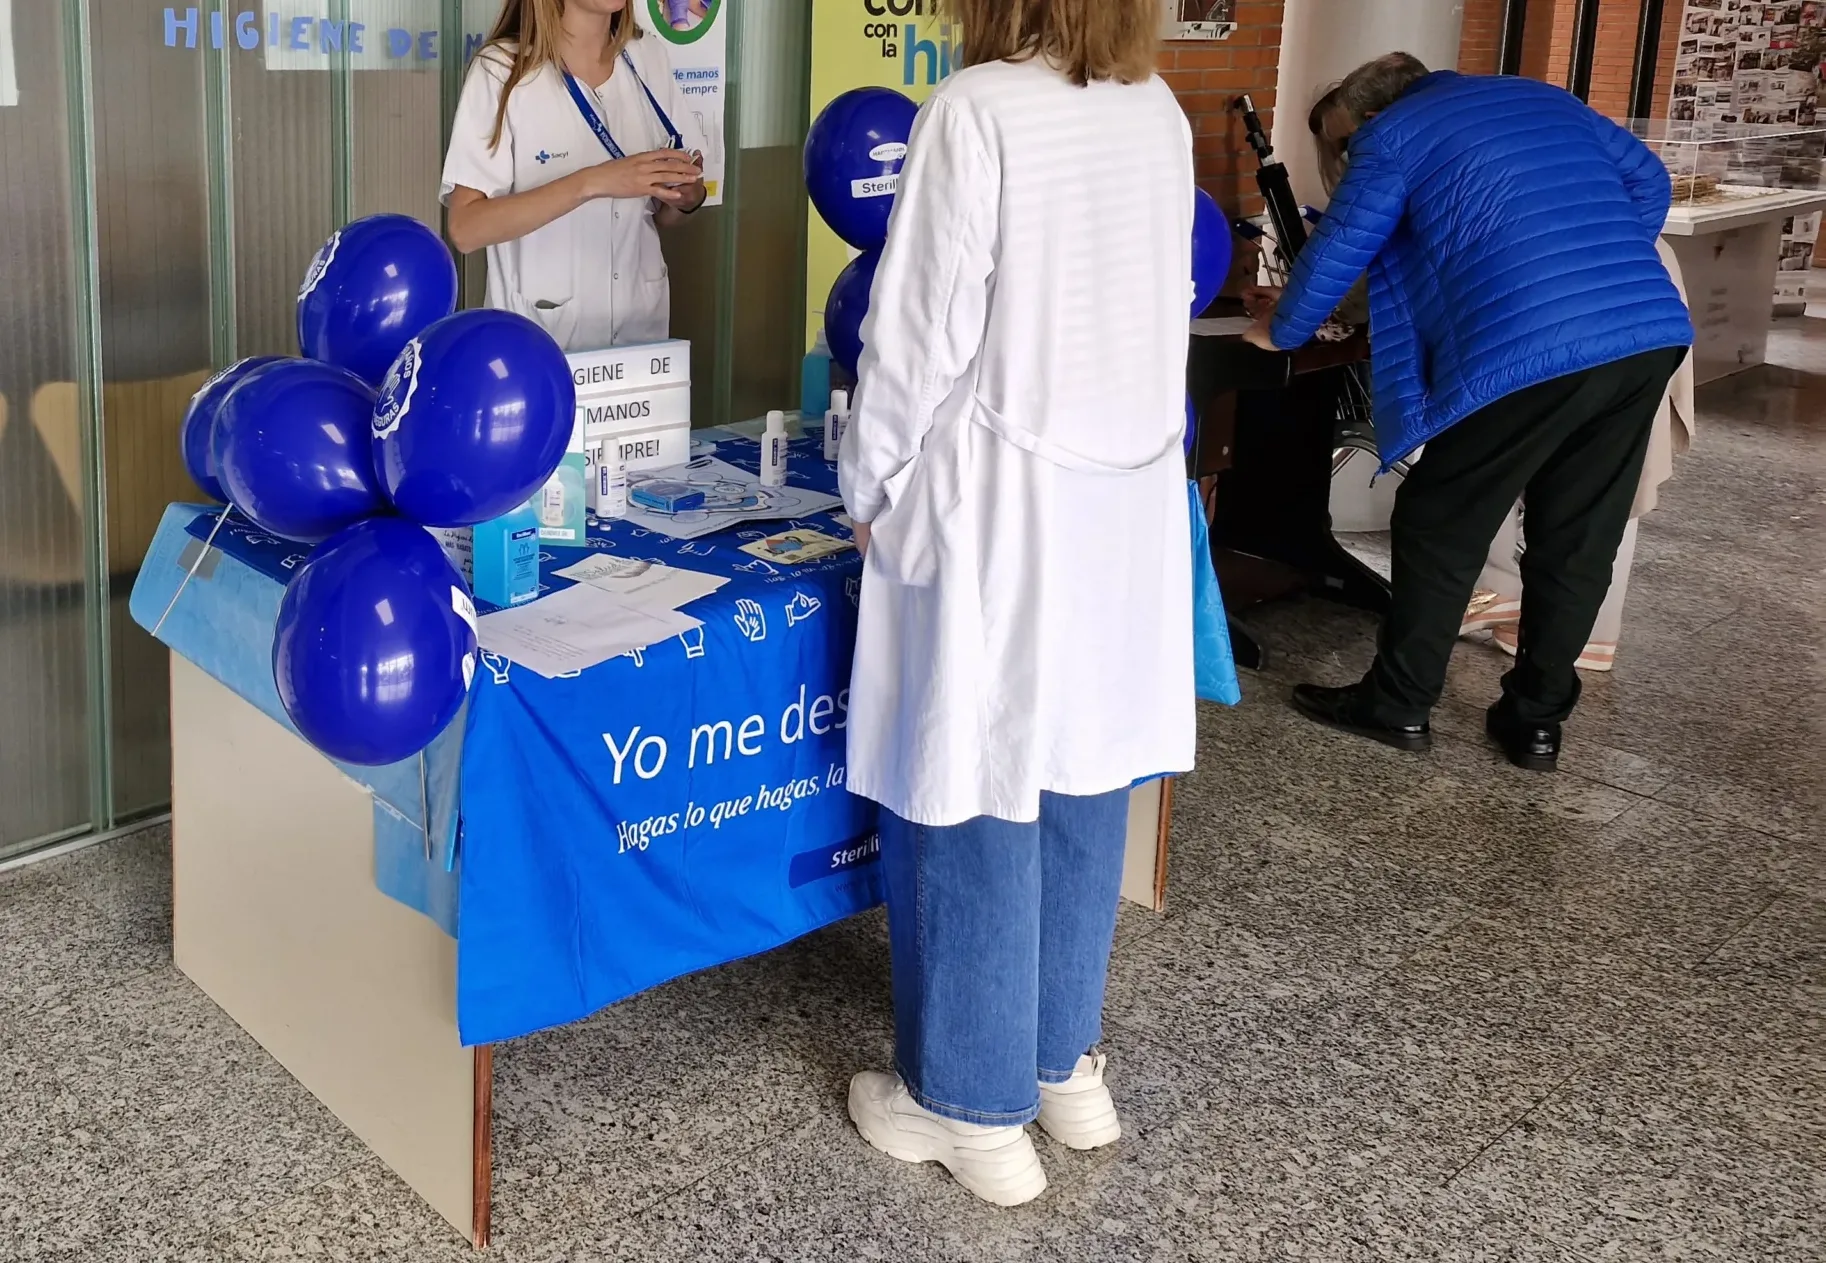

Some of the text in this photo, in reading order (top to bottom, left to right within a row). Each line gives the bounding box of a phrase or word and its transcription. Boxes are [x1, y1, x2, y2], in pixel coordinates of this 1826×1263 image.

[163, 7, 365, 54] HIGIENE
[387, 28, 438, 59] DE
[864, 23, 897, 38] con
[881, 38, 897, 58] la
[686, 69, 719, 79] manos
[680, 84, 718, 96] iempre
[650, 356, 671, 375] DE
[586, 400, 651, 425] MANOS
[585, 439, 660, 467] SIPRE!
[602, 725, 668, 784] Yo
[688, 714, 765, 769] me
[616, 763, 845, 854] Hagas lo que hagas, la
[830, 833, 881, 868] Sterilli
